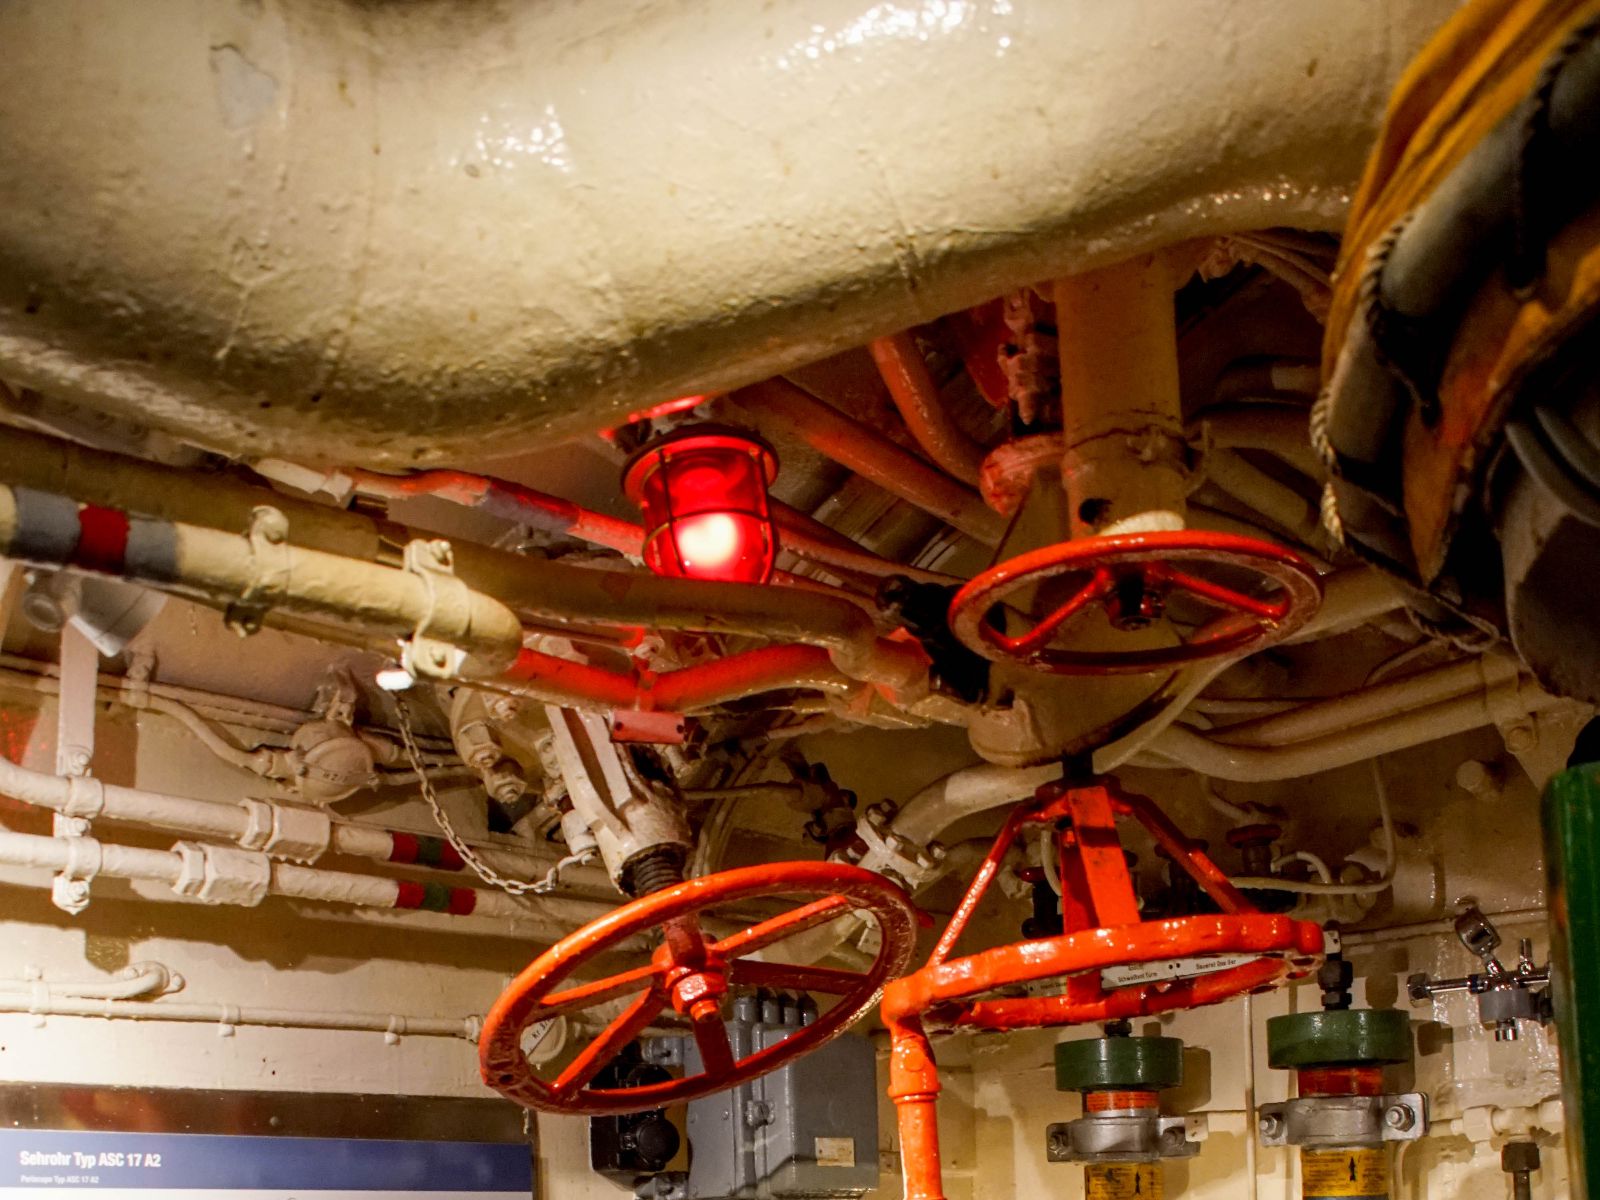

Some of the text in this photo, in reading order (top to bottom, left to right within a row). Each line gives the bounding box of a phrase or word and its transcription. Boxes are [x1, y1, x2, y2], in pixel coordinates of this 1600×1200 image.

[20, 1151, 162, 1169] Sehrohr Typ ASC 17 A2
